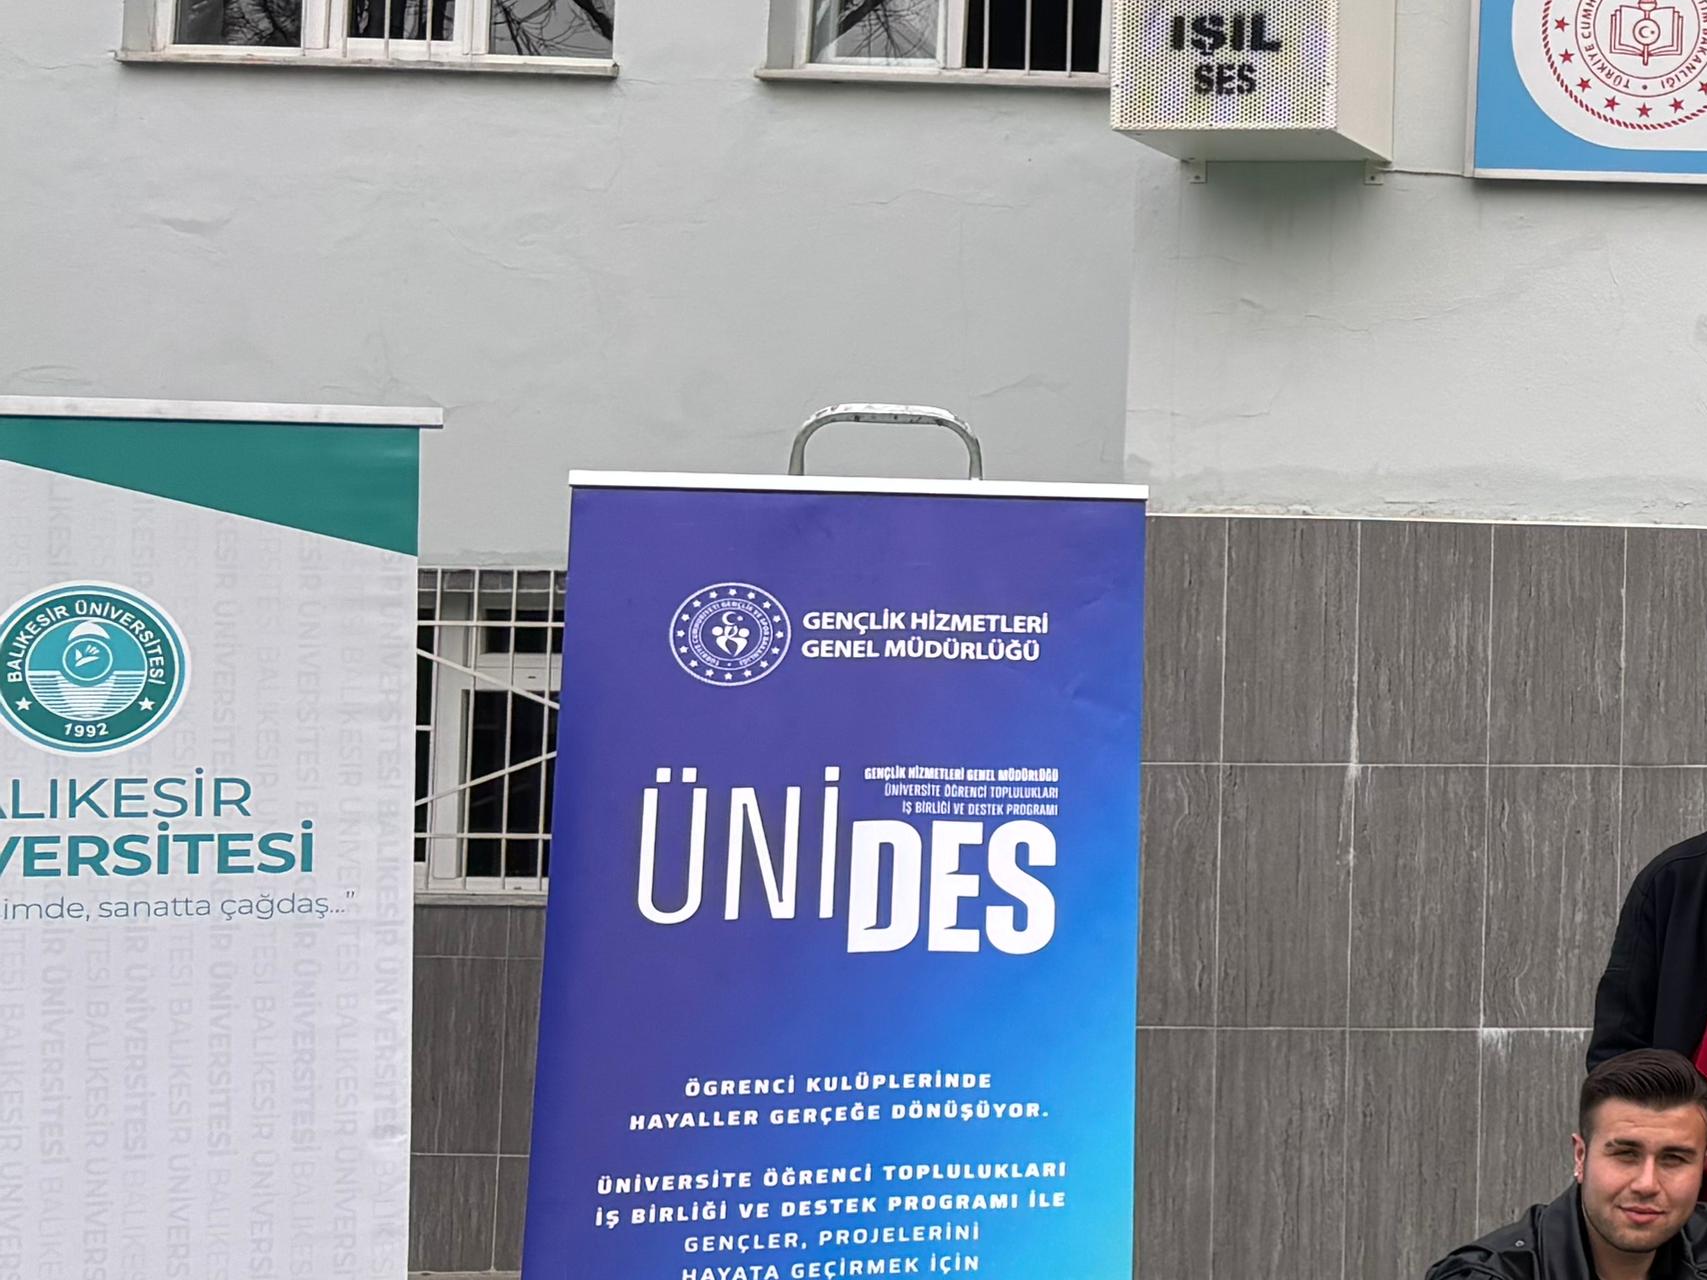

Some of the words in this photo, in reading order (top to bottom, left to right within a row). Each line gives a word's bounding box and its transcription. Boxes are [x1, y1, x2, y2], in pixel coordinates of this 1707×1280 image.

[1194, 63, 1257, 94] SES
[1584, 43, 1631, 89] TÜRKİYE
[802, 608, 906, 634] GENÇLİK
[910, 609, 1048, 634] HİZMETLERİ
[6, 605, 70, 683] BALIKESİR
[75, 600, 166, 685] ÜNİVERSİTESİ
[801, 639, 879, 658] GENEL
[884, 636, 1040, 661] MÜDÜRLÜĞÜ
[64, 722, 109, 738] 1992
[864, 765, 906, 781] GENÇLİK
[908, 765, 965, 781] HİZMETLERİ
[966, 768, 995, 781] GENEL
[0, 767, 252, 819] LIKESİR
[990, 786, 1058, 799] TOPLULUKLARI
[953, 803, 964, 815] VE
[968, 804, 1003, 816] DESTEK
[1006, 804, 1058, 816] PROGRAMI
[99, 897, 211, 919] sanatta
[806, 1070, 991, 1093] KULÜPLERİNDE
[629, 1110, 759, 1130] HAYALLER
[770, 1102, 881, 1125] GERÇEĞE
[892, 1100, 1048, 1121] DÖNÜŞÜYOR.
[597, 1170, 752, 1195] ÜNİVERSİTE
[763, 1163, 872, 1187] ÖĞRENCİ
[883, 1161, 1066, 1180] TOPLULUKLARI
[595, 1207, 620, 1229] İŞ
[631, 1200, 727, 1224] BİRLİĞİ
[738, 1203, 770, 1219] VE
[781, 1197, 877, 1217] DESTEK
[888, 1193, 1018, 1212] PROGRAMI
[1029, 1189, 1065, 1208] İLE
[684, 1232, 807, 1254] GENÇLER,
[819, 1221, 979, 1246] PROJELERİNİ
[791, 1257, 919, 1280] GEÇİRMEK
[930, 1252, 979, 1274] İÇİN
